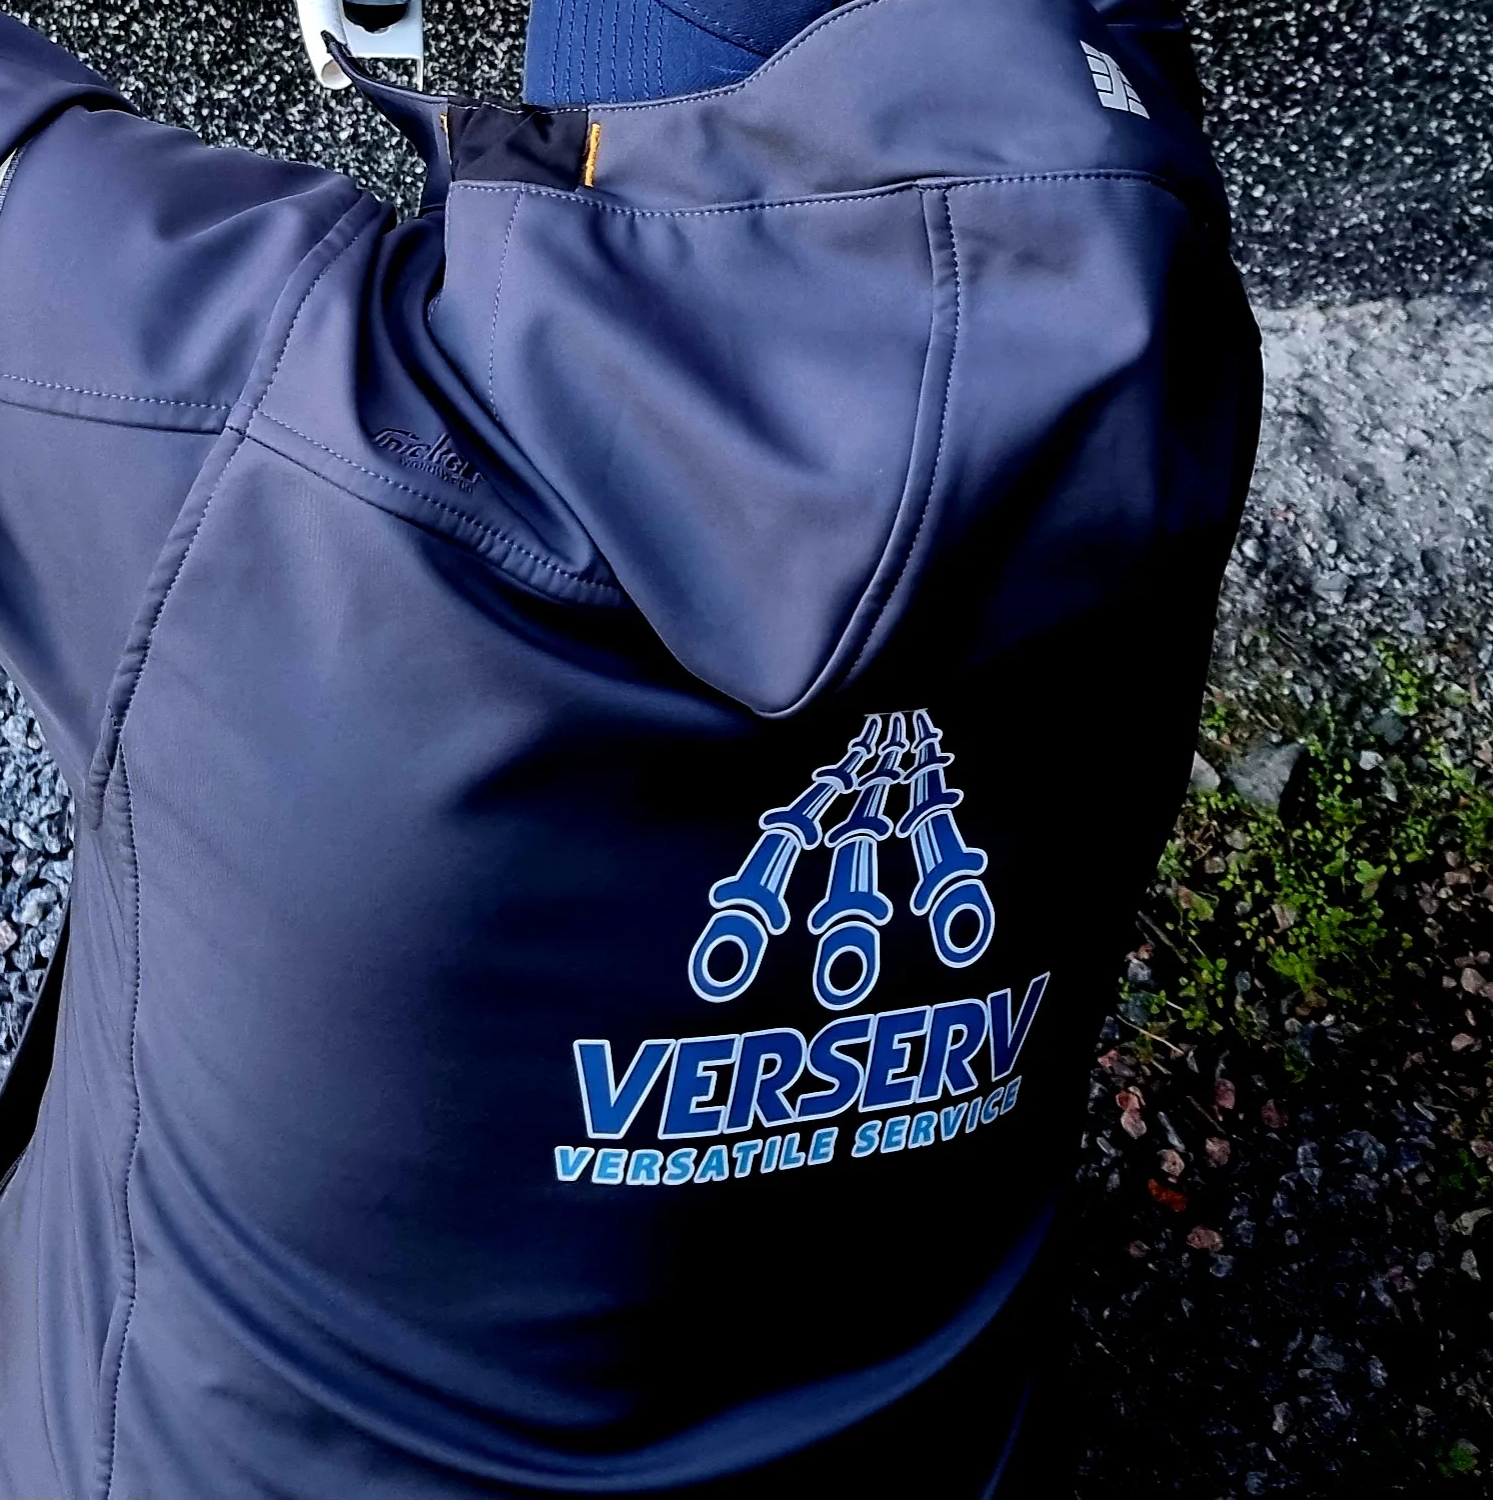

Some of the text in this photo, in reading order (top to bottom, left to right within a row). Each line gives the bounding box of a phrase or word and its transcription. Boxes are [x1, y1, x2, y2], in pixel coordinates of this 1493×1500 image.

[572, 971, 1052, 1140] VERSERV
[554, 1075, 1022, 1186] VERSATILE SERVICE
